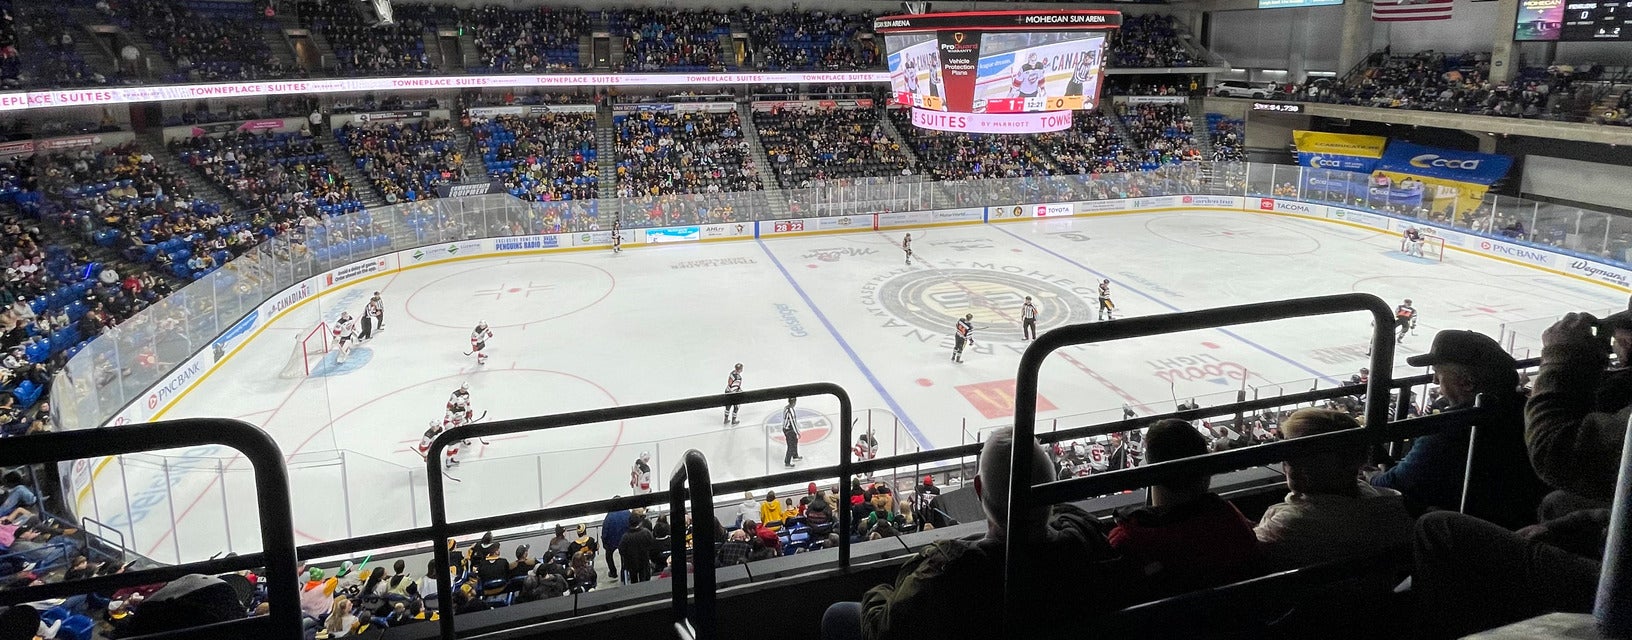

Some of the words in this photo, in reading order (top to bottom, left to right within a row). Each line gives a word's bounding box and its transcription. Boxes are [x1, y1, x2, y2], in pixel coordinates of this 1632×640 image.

[1025, 16, 1069, 24] MOHEGAN
[60, 92, 112, 103] SUITES
[190, 85, 261, 95] TOWNEPLACE
[268, 83, 307, 92] SUITES
[1009, 100, 1015, 110] 1
[1056, 99, 1064, 108] 0
[922, 113, 966, 128] SUITES
[449, 188, 489, 197] EQUIPMENT
[1277, 202, 1310, 213] TACOMA
[1493, 244, 1516, 255] PNC
[1517, 249, 1548, 263] BANK
[1570, 260, 1626, 282] Wegmans
[277, 287, 309, 312] CANADIAN
[1146, 354, 1221, 369] LIGHT
[1152, 361, 1262, 383] Coors
[158, 380, 178, 402] PNC
[178, 362, 201, 386] BANK
